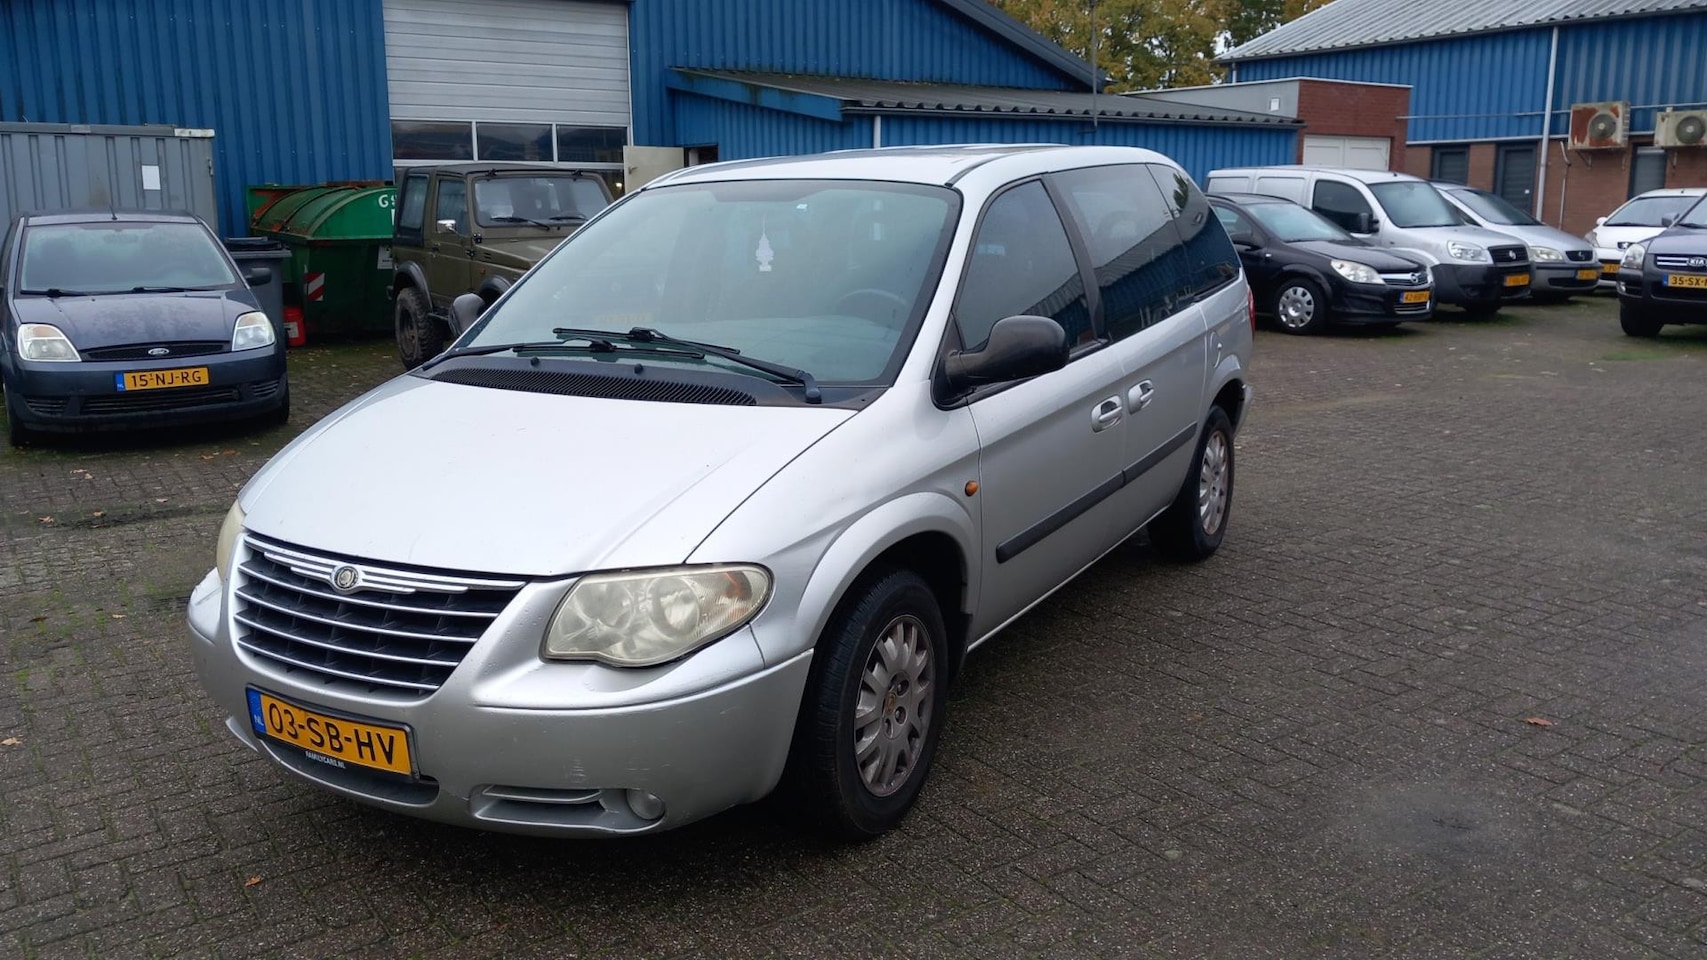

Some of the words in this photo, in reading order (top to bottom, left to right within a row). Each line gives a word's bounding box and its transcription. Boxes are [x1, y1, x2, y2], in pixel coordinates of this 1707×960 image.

[131, 370, 202, 388] 15-NJ-RG
[254, 714, 264, 727] NL
[268, 702, 395, 765] 03-SB-HV
